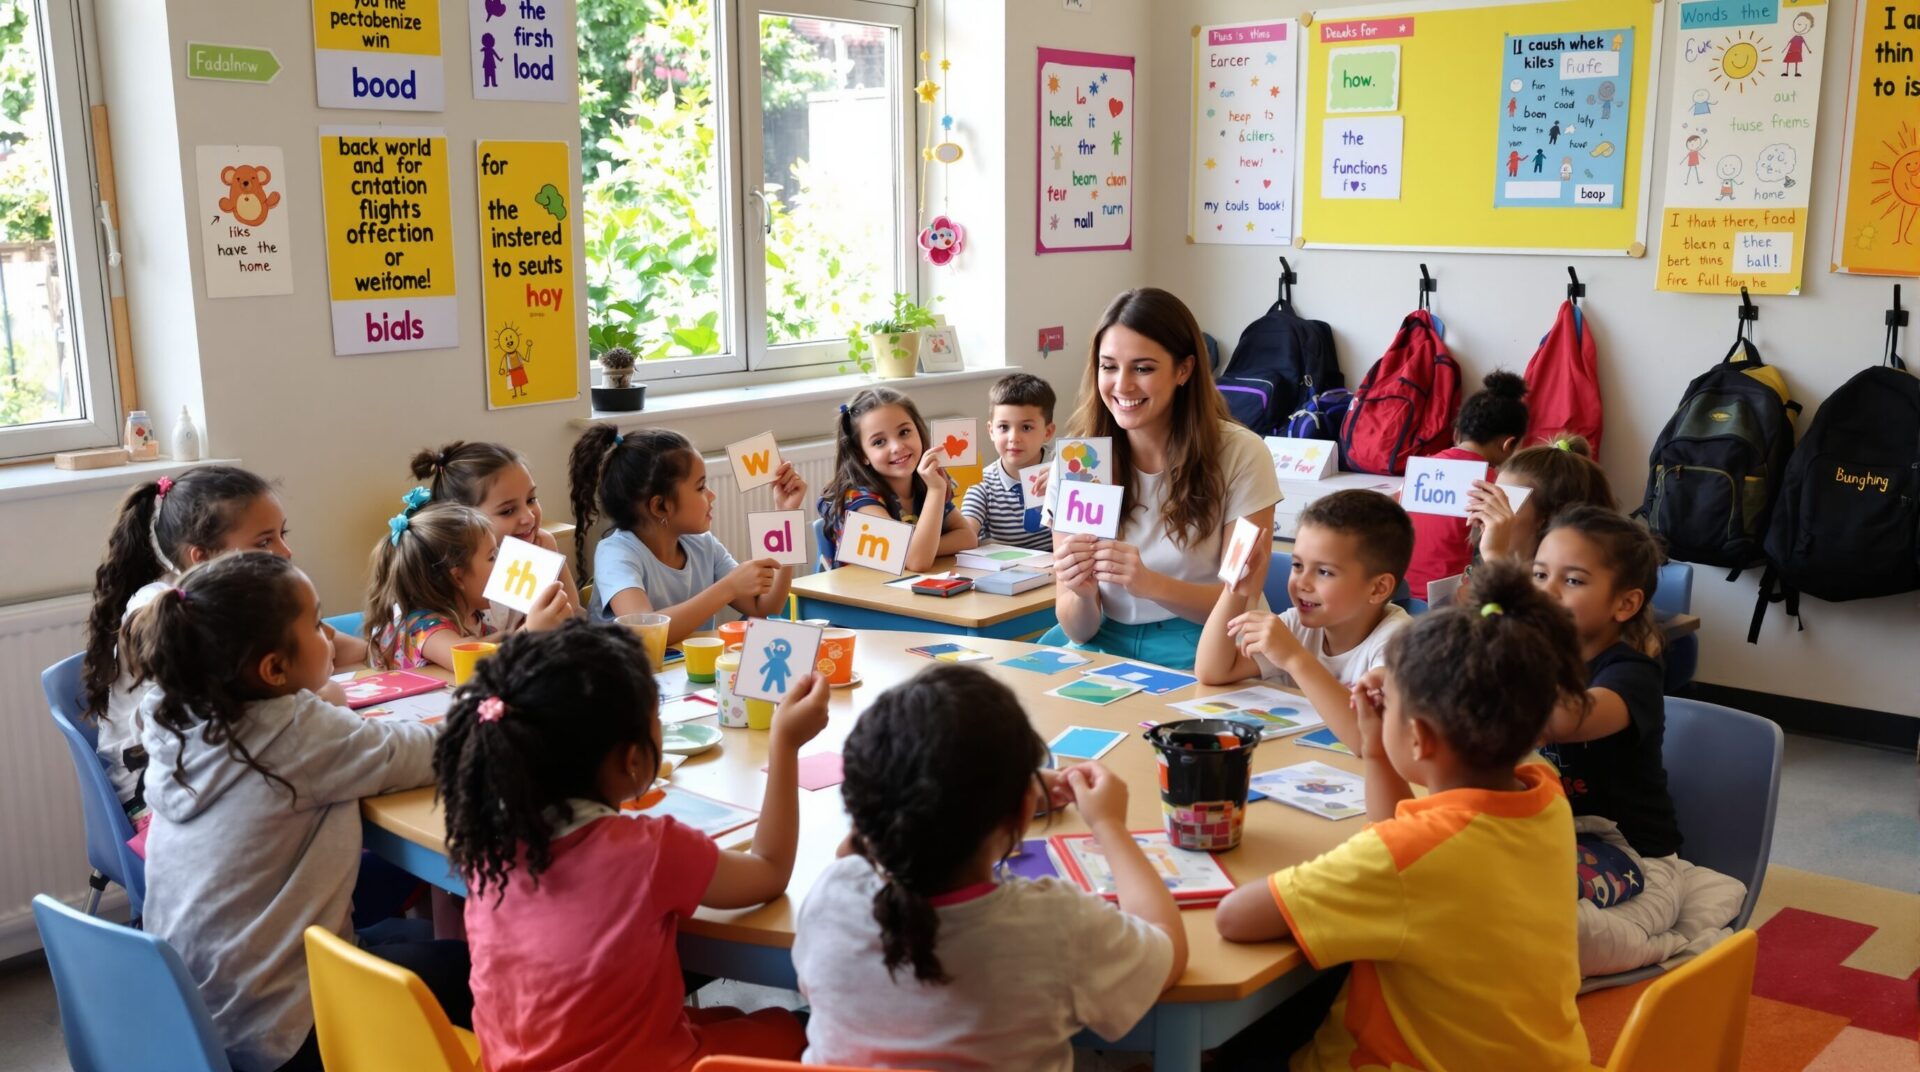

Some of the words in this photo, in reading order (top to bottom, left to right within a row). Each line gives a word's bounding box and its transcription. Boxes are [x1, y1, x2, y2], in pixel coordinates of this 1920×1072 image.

[330, 10, 422, 31] pectobenize
[519, 1, 546, 20] the
[1884, 6, 1896, 30] I
[362, 32, 390, 48] win
[1875, 41, 1914, 63] thin
[513, 53, 554, 80] lood
[1524, 56, 1554, 69] kiles
[352, 67, 416, 99] bood
[1873, 77, 1896, 97] to
[1088, 113, 1096, 128] it
[339, 136, 379, 156] back
[385, 138, 431, 156] world
[1342, 129, 1364, 145] the
[353, 156, 384, 174] and
[397, 156, 423, 174] for
[481, 153, 508, 175] for
[1333, 158, 1388, 175] functions
[1754, 187, 1785, 200] home
[360, 198, 421, 225] flights
[488, 199, 518, 220] the
[1204, 201, 1219, 214] my
[1671, 213, 1679, 228] I
[346, 222, 433, 244] offection
[491, 223, 562, 248] instered
[217, 244, 248, 256] have
[257, 241, 278, 254] the
[239, 260, 271, 272] home
[384, 251, 404, 267] or
[492, 258, 512, 278] to
[518, 254, 563, 276] seuts
[1753, 274, 1767, 288] he
[526, 283, 563, 312] hoy
[366, 309, 424, 343] bials
[1435, 469, 1445, 481] it
[1414, 473, 1456, 505] fuon
[763, 520, 793, 552] al
[504, 559, 537, 600] th
